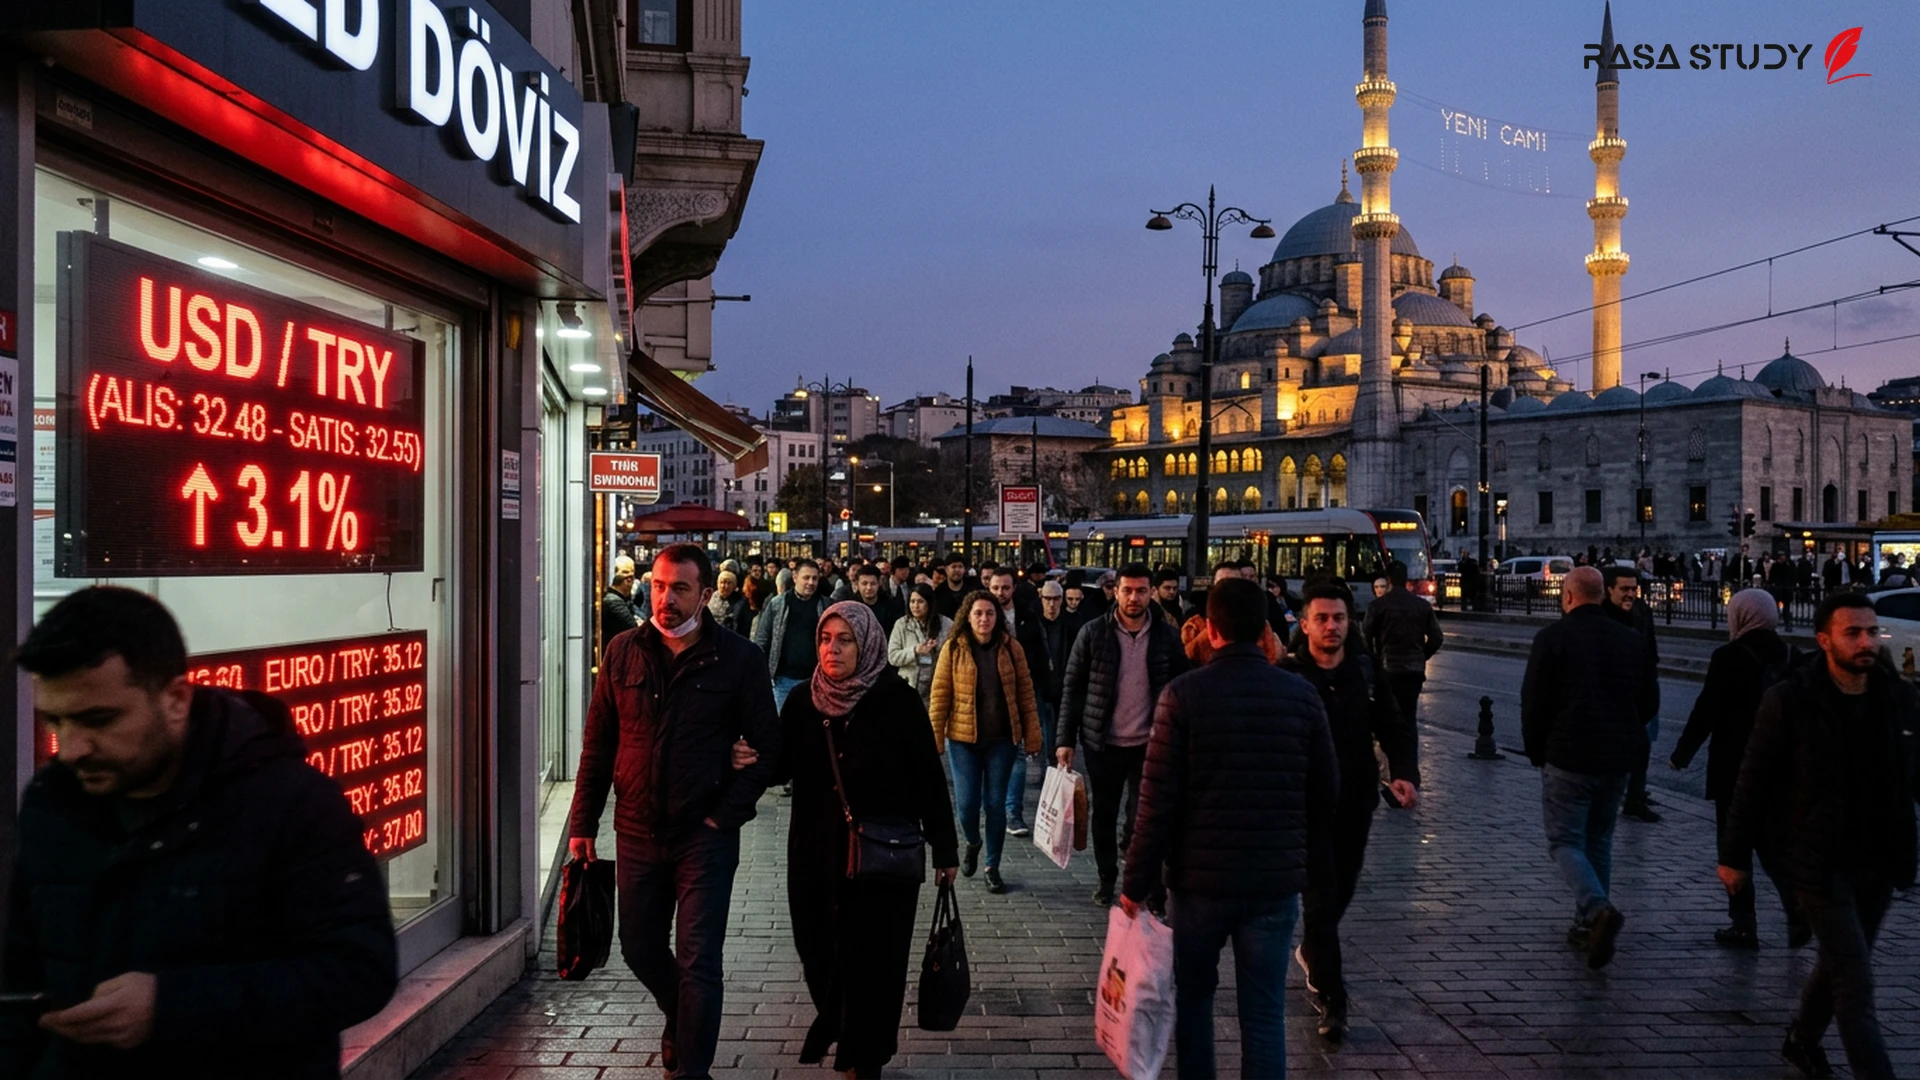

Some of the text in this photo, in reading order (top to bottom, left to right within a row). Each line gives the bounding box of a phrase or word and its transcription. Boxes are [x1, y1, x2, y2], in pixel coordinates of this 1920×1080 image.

[411, 0, 581, 224] DÖVİZ
[140, 276, 393, 410] USD / TRY
[88, 373, 183, 430] (ALIS:
[193, 393, 267, 442] 32.48
[289, 411, 361, 457] SATIS:
[365, 425, 422, 472] 32.55)
[236, 464, 359, 551] 3.1%
[265, 654, 326, 693] EURO
[338, 646, 379, 681] TRY:
[382, 640, 423, 673] 35.12
[291, 702, 325, 736] RO
[338, 692, 379, 727] TRY:
[382, 683, 423, 717] 35.92
[338, 736, 379, 773] TRY:
[382, 726, 423, 762] 35.12
